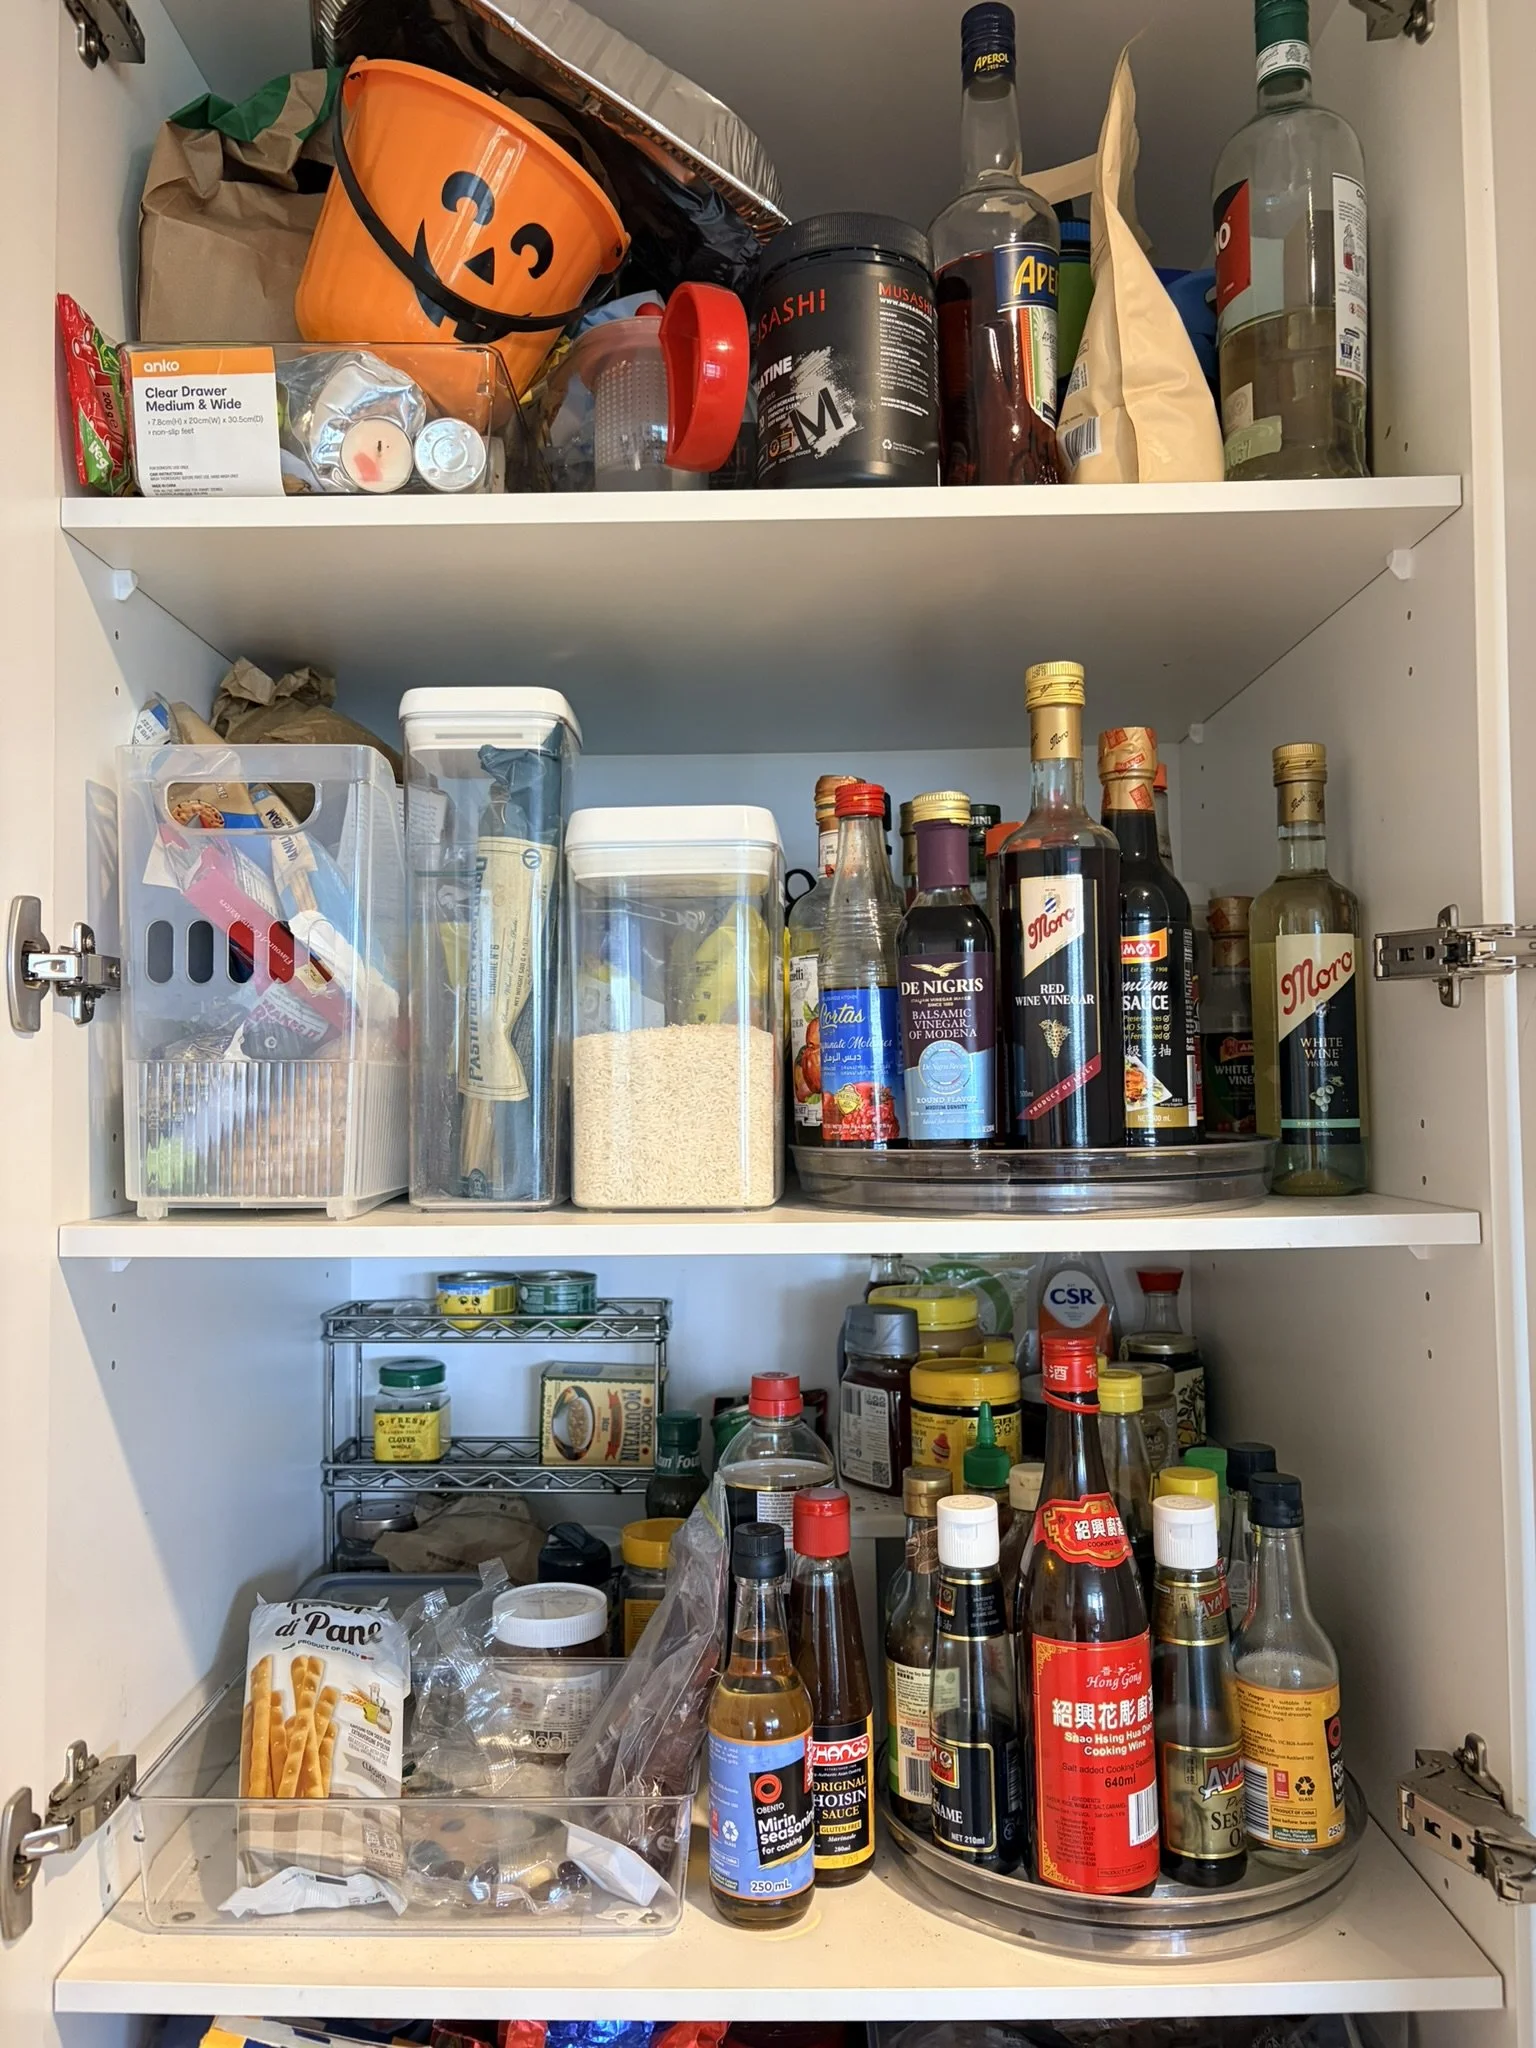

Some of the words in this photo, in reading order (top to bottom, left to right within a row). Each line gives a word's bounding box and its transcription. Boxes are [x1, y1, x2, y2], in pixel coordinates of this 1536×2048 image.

[974, 52, 1010, 72] APEROL
[879, 281, 933, 317] MUSASHI
[143, 359, 179, 373] anko
[145, 387, 178, 399] Clear
[181, 386, 227, 397] Drawer
[146, 400, 195, 412] Medium
[198, 399, 207, 411] &
[210, 398, 242, 410] Wide
[152, 417, 182, 426] 7.8cm(H)
[188, 416, 221, 425] 20cm(W)
[227, 415, 264, 424] 30.5cm(D)
[152, 429, 180, 437] non-slip
[181, 427, 195, 435] feet
[1028, 906, 1076, 950] Moro
[901, 981, 920, 996] DE
[923, 977, 984, 995] NIGRIS
[1040, 983, 1065, 994] RED
[1281, 951, 1353, 1016] Moro
[1015, 995, 1041, 1006] WINE
[1042, 994, 1095, 1005] VINEGAR
[1122, 995, 1169, 1011] SAUCE
[820, 1003, 865, 1029] Cortas
[912, 1008, 972, 1020] BALSAMIC
[914, 1019, 971, 1029] VINEGAR
[908, 1030, 922, 1040] OF
[924, 1028, 977, 1040] MODENA
[1300, 1037, 1343, 1048] WHITE
[1304, 1048, 1340, 1059] WINE
[1214, 1065, 1248, 1075] WHITE
[1028, 1090, 1060, 1115] PRODUCT
[1050, 1288, 1097, 1305] CSR
[620, 1389, 642, 1464] MOUNTAIN
[642, 1406, 653, 1446] ROCKY
[275, 1618, 301, 1637] di
[304, 1611, 382, 1645] Pane
[298, 1639, 329, 1650] PRODUCT
[341, 1648, 360, 1658] ITALY
[1086, 1676, 1119, 1691] Hong
[1121, 1670, 1143, 1690] Gong
[1064, 1731, 1093, 1744] Shao
[1095, 1731, 1125, 1746] Hsing
[1126, 1728, 1141, 1741] Hua
[1084, 1744, 1127, 1757] Cooking
[1128, 1738, 1147, 1753] Wine
[1061, 1762, 1077, 1773] Salt
[1079, 1765, 1104, 1774] added
[1106, 1762, 1134, 1774] Cooking
[813, 1775, 867, 1792] ORIGINAL
[1105, 1773, 1136, 1788] 640ml
[813, 1786, 867, 1807] HOISIN
[756, 1802, 785, 1815] OBENTO
[822, 1805, 860, 1819] SAUCE
[757, 1813, 797, 1834] Mirin
[821, 1825, 847, 1834] GLUTEN
[762, 1845, 775, 1857] for
[776, 1834, 803, 1853] cooking
[951, 1832, 963, 1842] NET
[964, 1835, 985, 1845] 210ml
[751, 1881, 772, 1892] 250
[774, 1878, 791, 1891] mL
